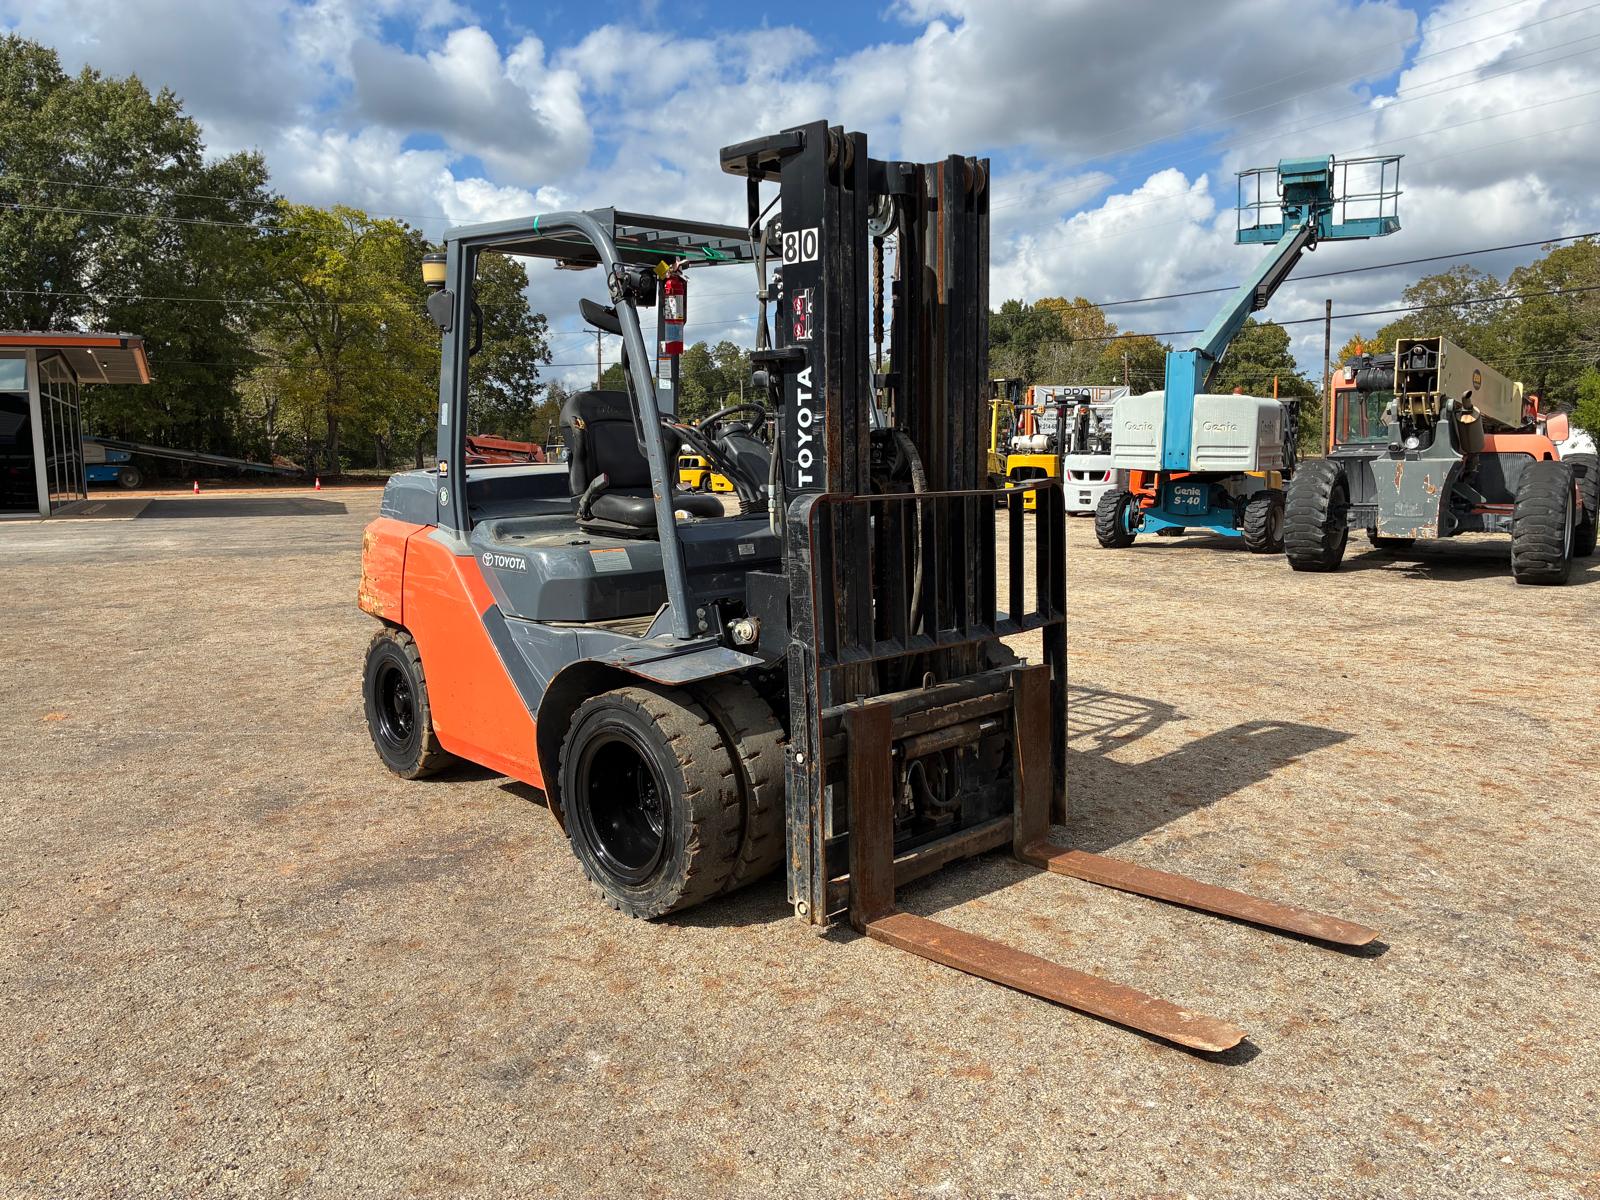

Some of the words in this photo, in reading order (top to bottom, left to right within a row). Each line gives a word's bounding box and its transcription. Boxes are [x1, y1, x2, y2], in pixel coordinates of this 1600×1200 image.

[784, 230, 817, 262] 80
[797, 366, 813, 487] TOYOTA
[1125, 420, 1153, 431] Genie
[1202, 420, 1238, 432] Genie
[1174, 486, 1201, 496] Genie
[494, 555, 526, 570] TOYOTA
